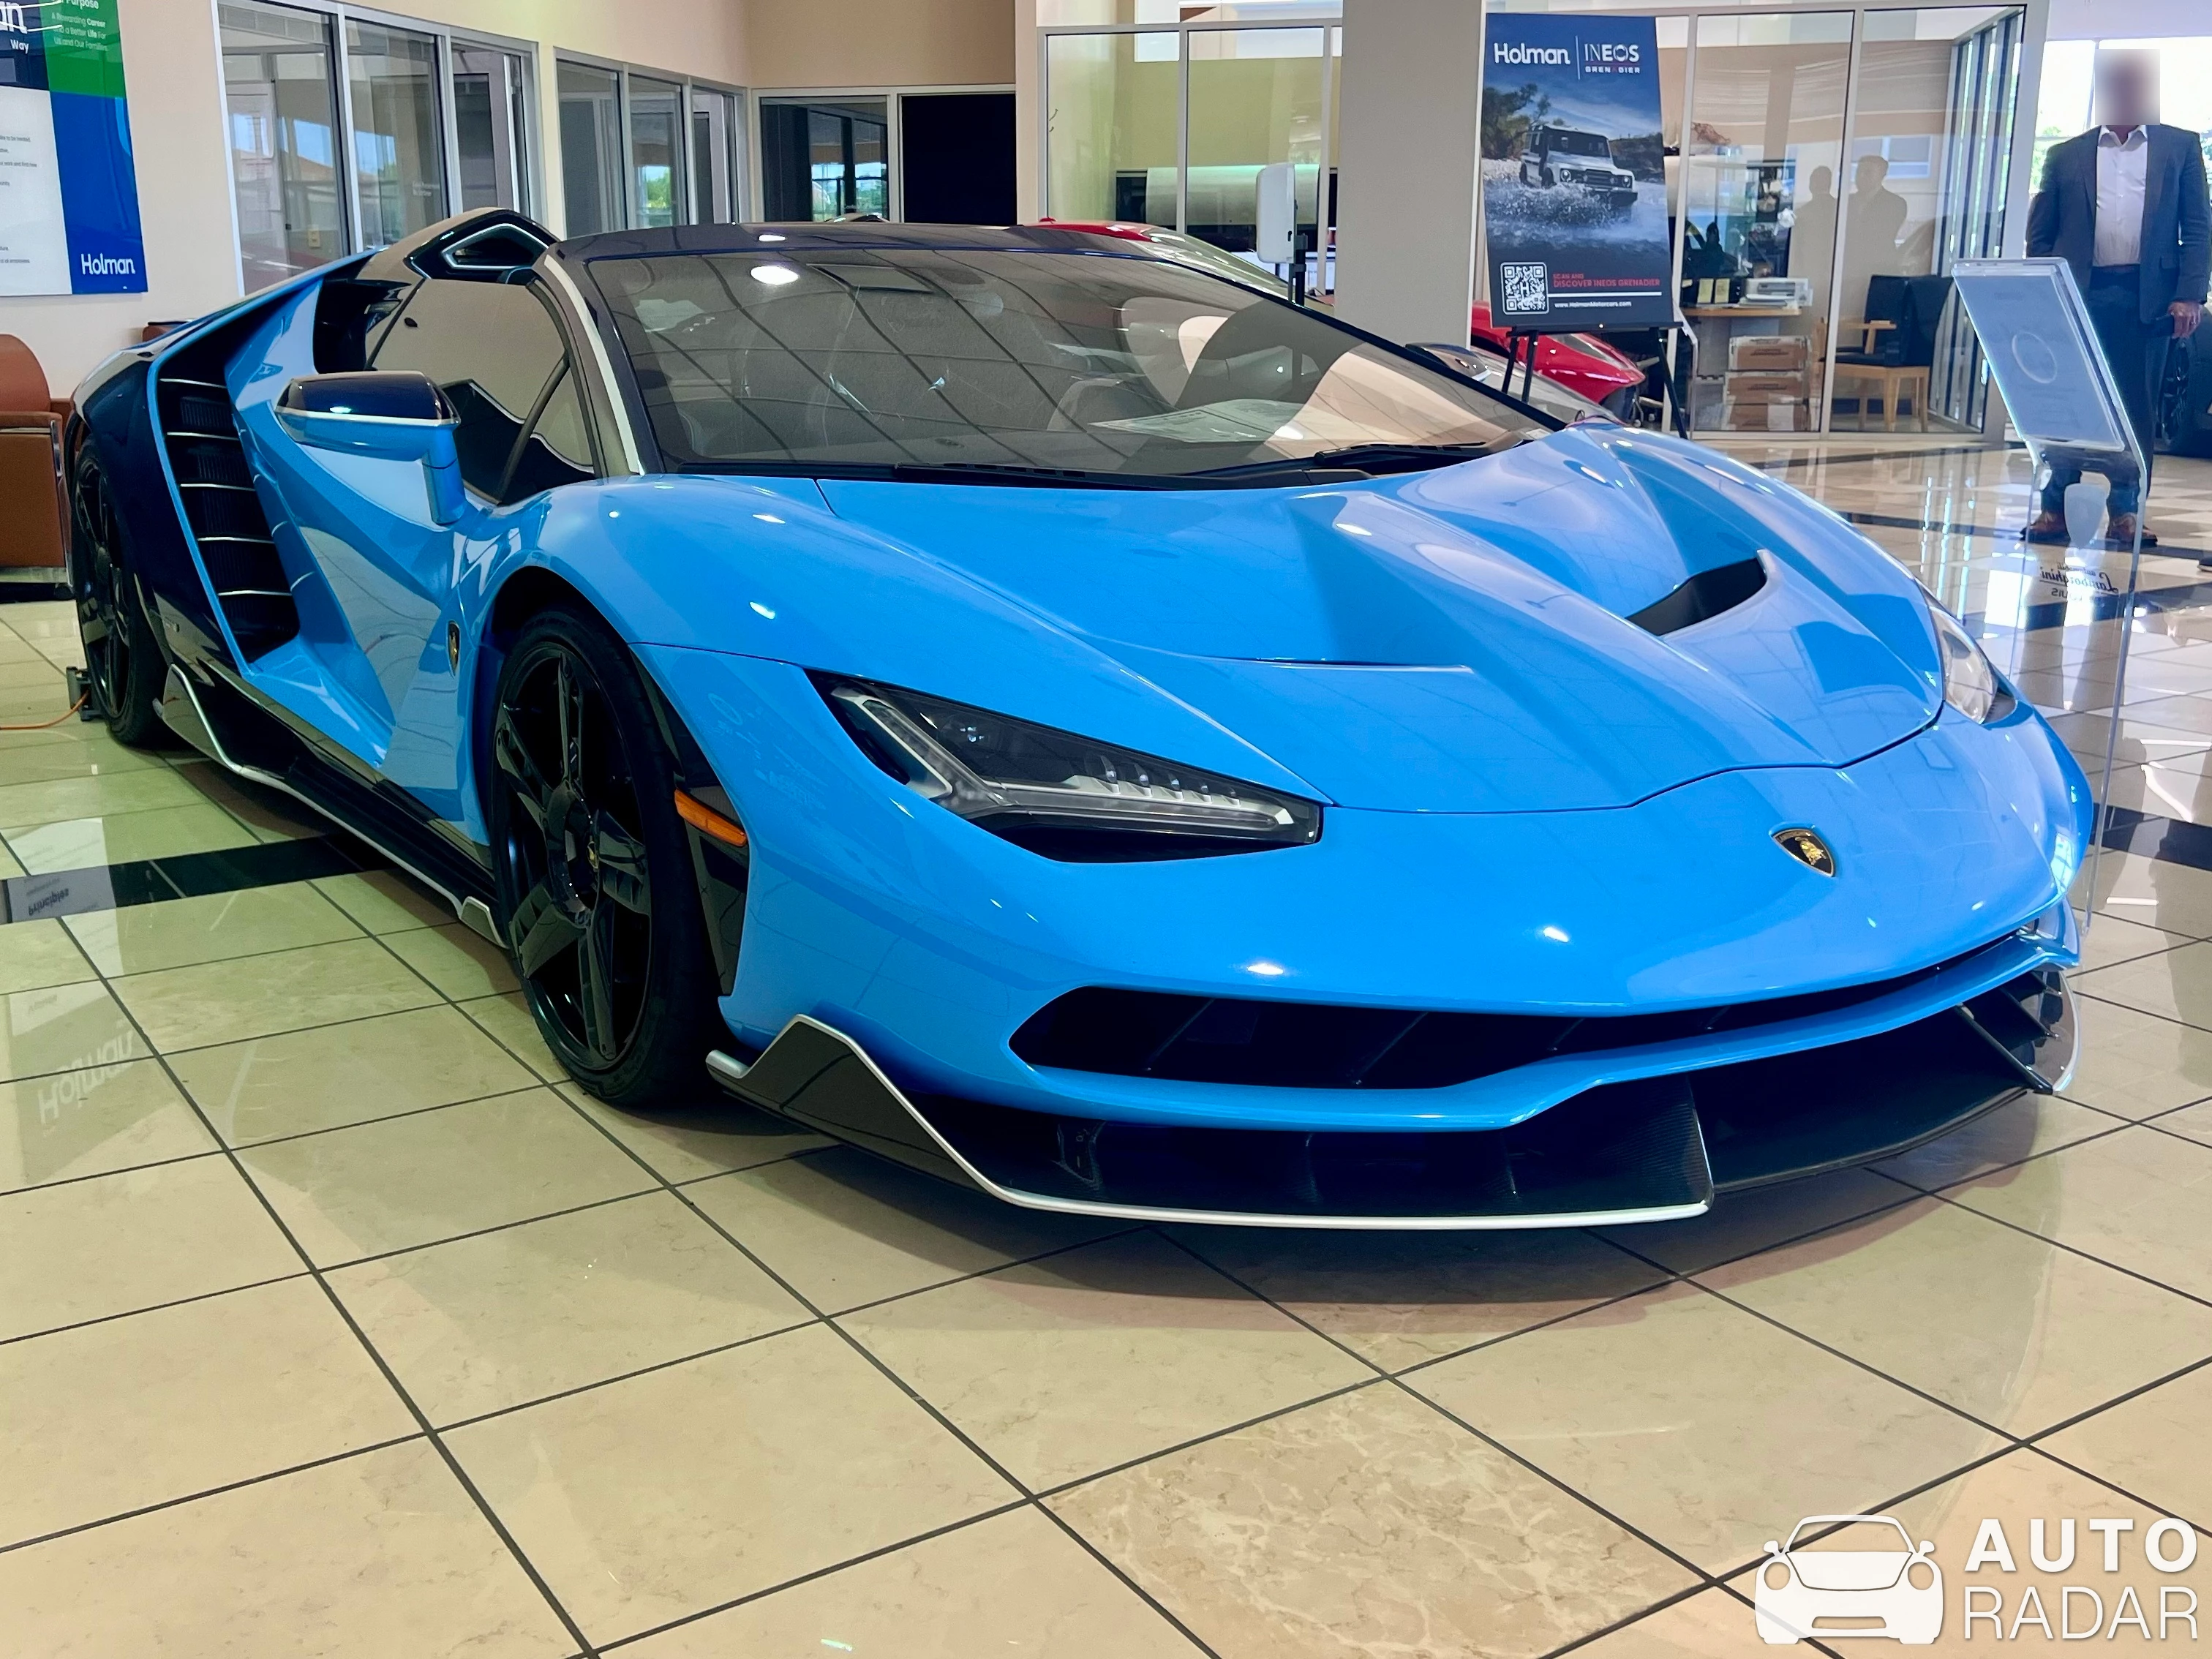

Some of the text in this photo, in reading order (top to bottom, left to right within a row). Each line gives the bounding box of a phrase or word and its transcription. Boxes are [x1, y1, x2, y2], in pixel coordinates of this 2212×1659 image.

[10, 39, 29, 54] Way
[1494, 42, 1640, 64] Holman INEOS
[1584, 66, 1641, 74] GRENADIER
[80, 252, 136, 275] Holman
[1553, 279, 1660, 287] DISCOVER INEOS GRENADIER
